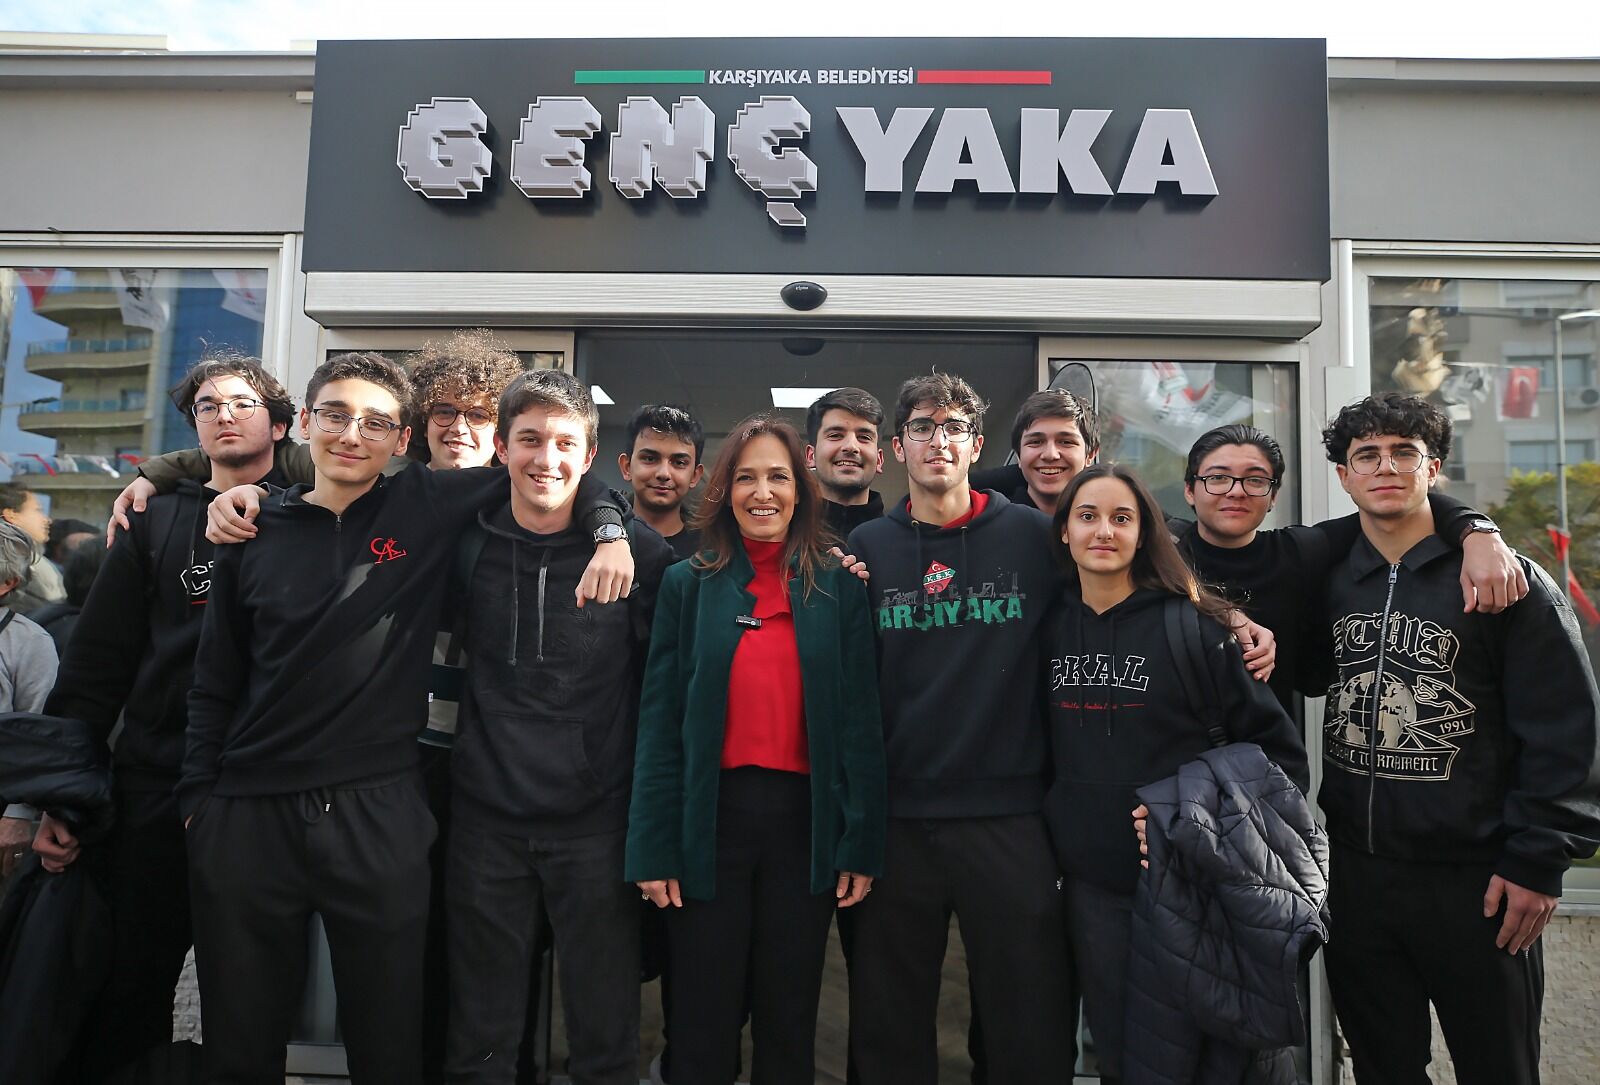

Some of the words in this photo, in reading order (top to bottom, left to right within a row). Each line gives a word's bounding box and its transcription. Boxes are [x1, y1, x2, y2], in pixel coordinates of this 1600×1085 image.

[708, 68, 812, 88] KARŞIYAKA
[817, 66, 914, 85] BELEDİYESİ
[396, 95, 818, 227] GENÇ
[835, 106, 1220, 197] YAKA
[1439, 719, 1466, 734] 1991
